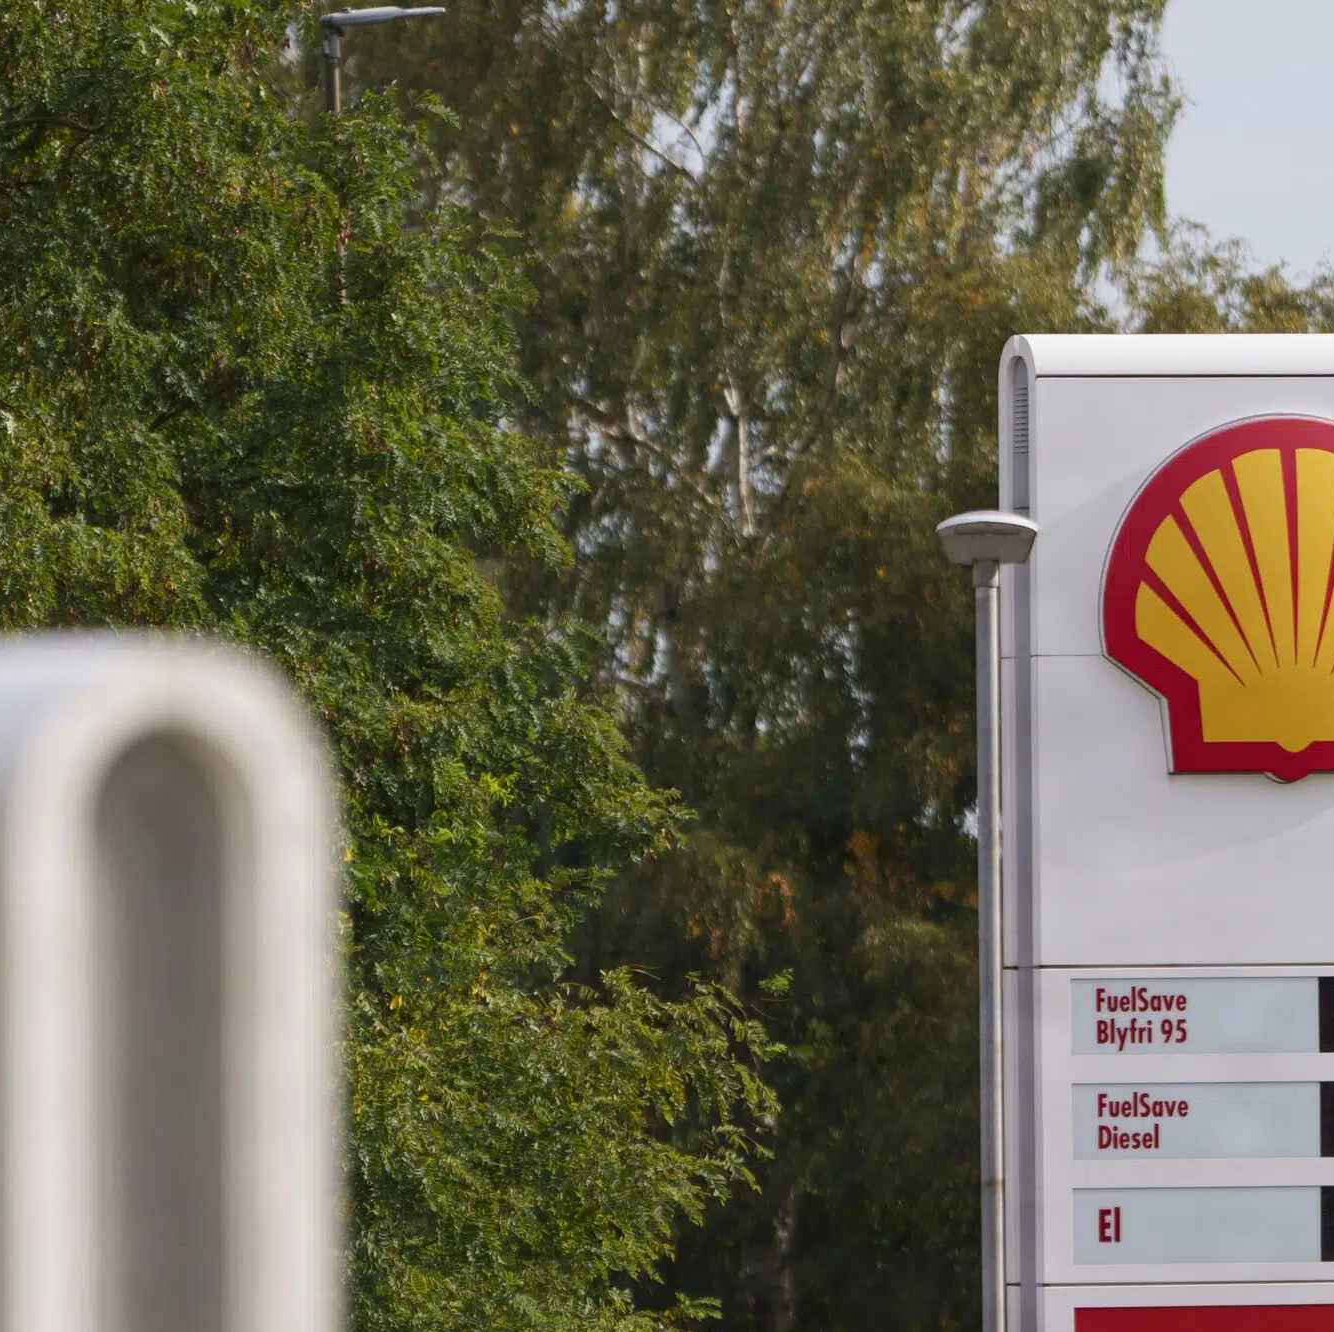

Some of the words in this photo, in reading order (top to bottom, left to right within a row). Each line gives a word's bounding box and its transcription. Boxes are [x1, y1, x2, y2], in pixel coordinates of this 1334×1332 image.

[1095, 986, 1187, 1012] FuelSave
[1095, 1018, 1153, 1051] Blyfri
[1160, 1019, 1187, 1044] 95
[1097, 1093, 1189, 1118] FuelSave
[1097, 1124, 1160, 1150] Diesel
